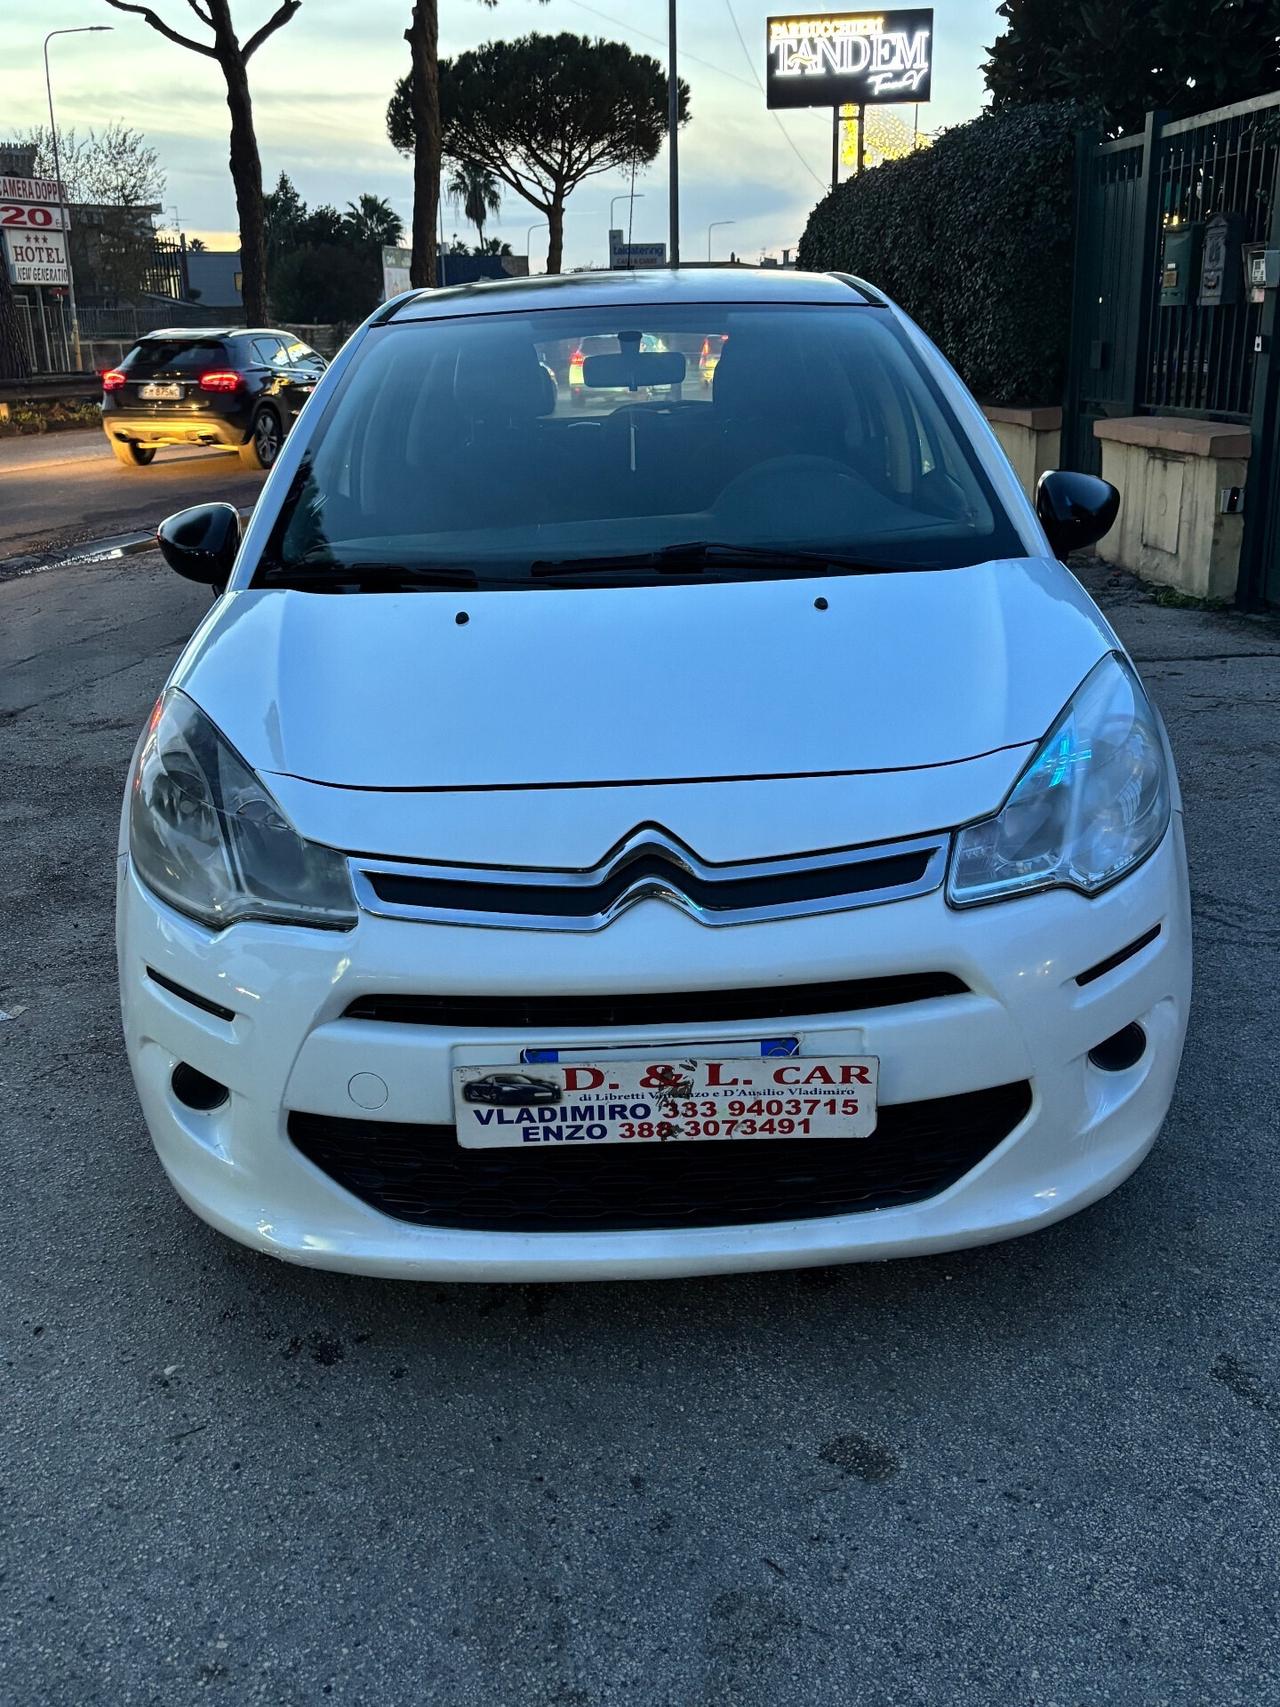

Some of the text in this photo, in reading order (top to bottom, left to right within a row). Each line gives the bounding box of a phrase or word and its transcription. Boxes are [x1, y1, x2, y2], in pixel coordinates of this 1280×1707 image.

[769, 31, 930, 76] TANDEM
[0, 180, 66, 200] AMERA DOPPA
[0, 206, 53, 226] 20
[13, 246, 65, 264] HOTEL
[17, 267, 70, 282] NEW GENERATIO
[773, 1065, 873, 1086] CAR
[580, 1093, 592, 1102] di
[595, 1092, 645, 1102] Libretti
[788, 1086, 855, 1096] Vladimiro
[473, 1098, 859, 1125] VLADIMIRO 333 9403715
[522, 1118, 811, 1143] ENZO 388 3073491
